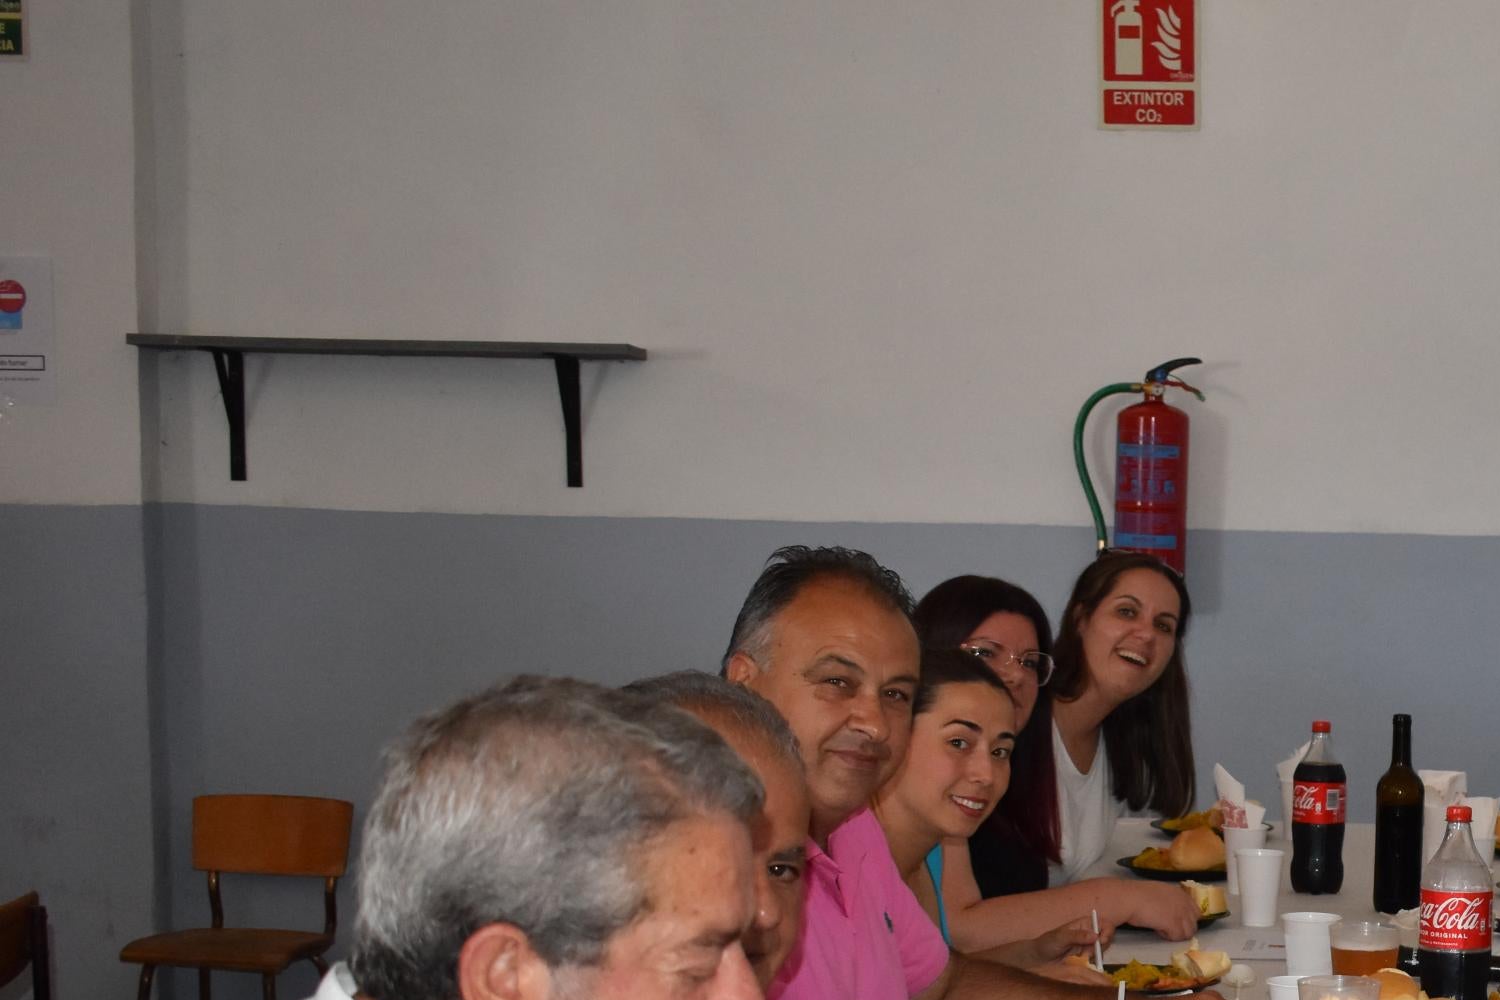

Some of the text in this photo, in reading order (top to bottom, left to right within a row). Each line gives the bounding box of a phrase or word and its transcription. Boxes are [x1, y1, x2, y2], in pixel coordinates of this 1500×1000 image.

[1113, 91, 1184, 106] EXTINTOR
[1135, 109, 1162, 123] CO2
[1430, 931, 1468, 940] ORIGINAL
